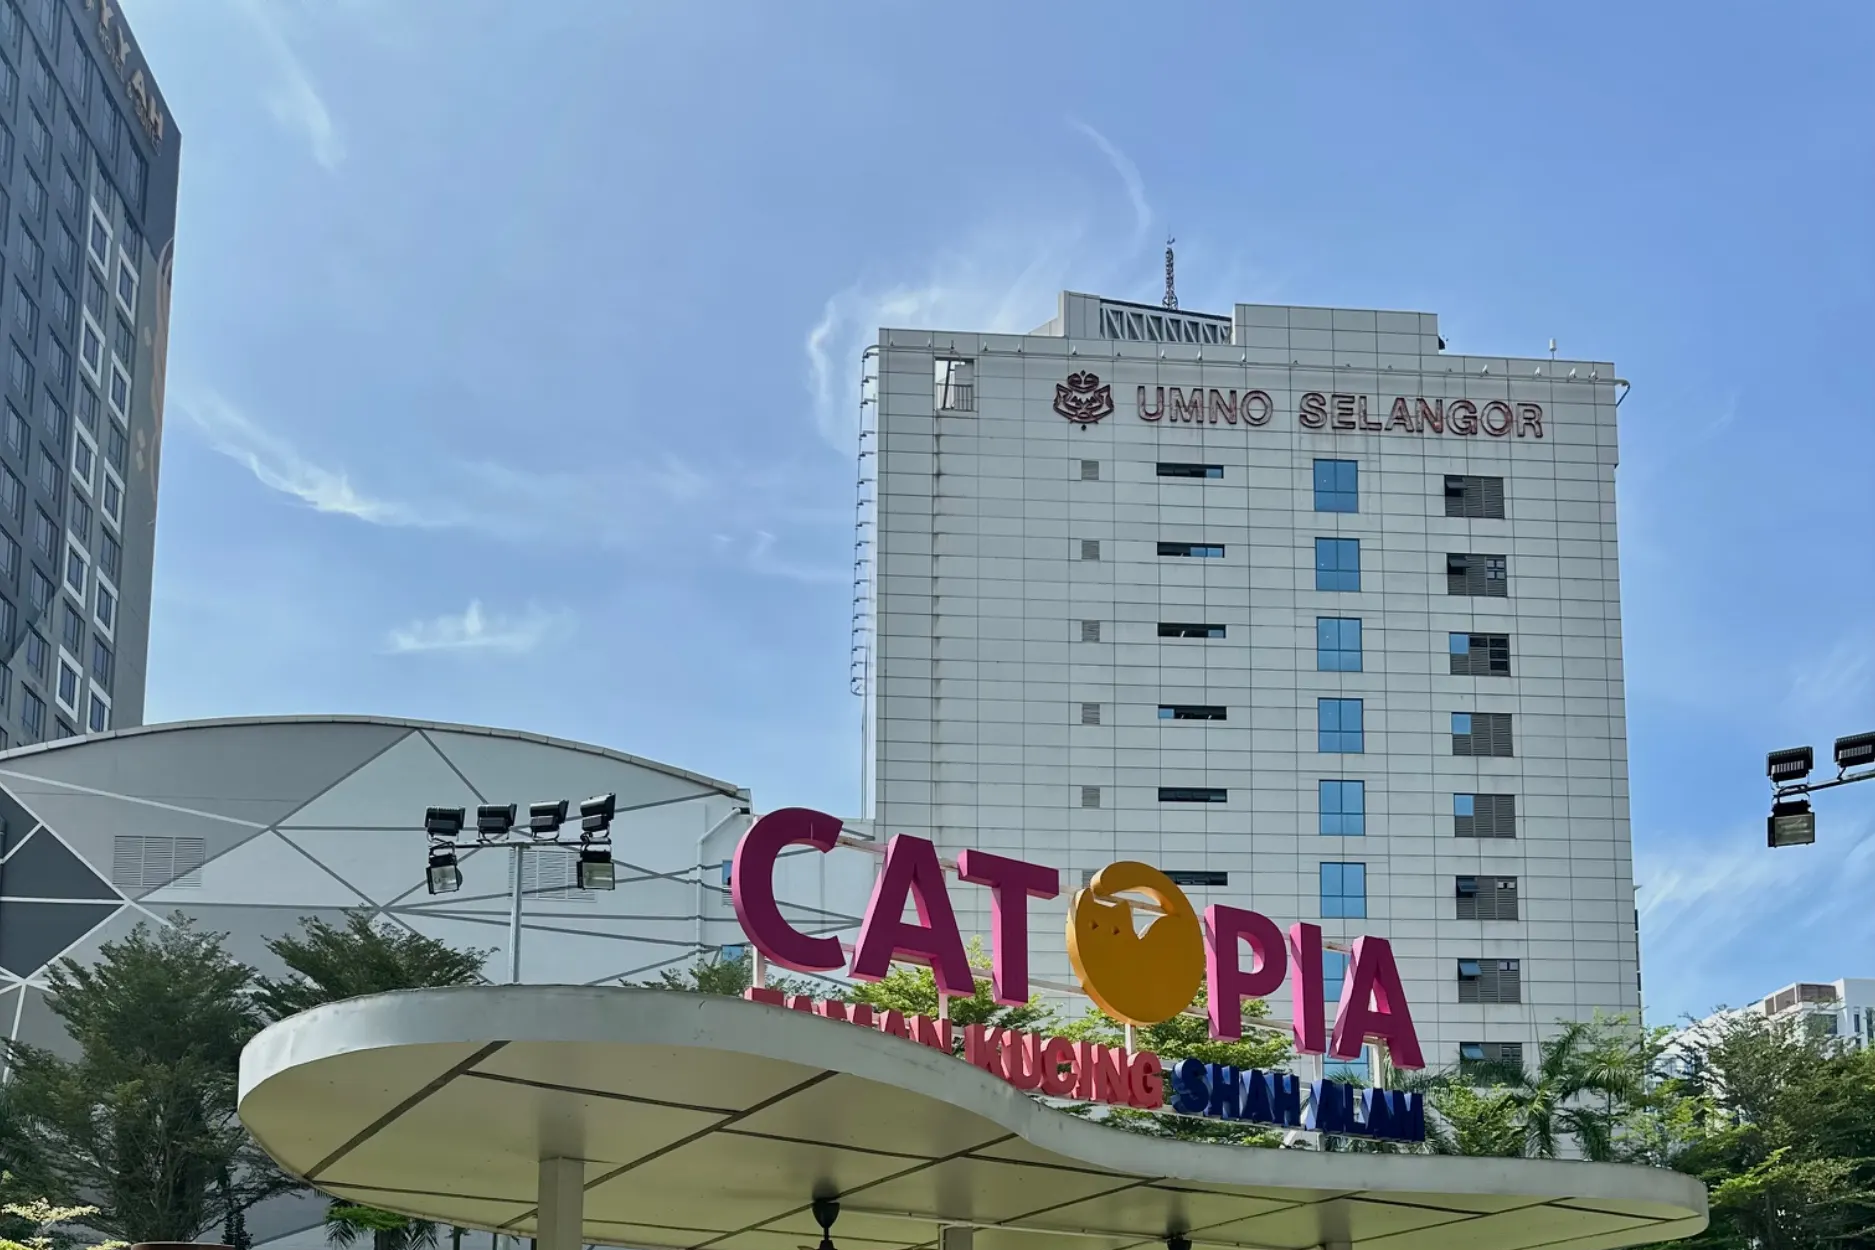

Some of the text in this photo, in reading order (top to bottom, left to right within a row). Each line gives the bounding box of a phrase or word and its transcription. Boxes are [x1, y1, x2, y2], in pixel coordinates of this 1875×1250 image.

[1137, 385, 1544, 439] UMNO SELANGOR
[964, 1023, 1163, 1109] KUCING
[1171, 1058, 1301, 1128] SHAH
[1304, 1078, 1426, 1142] ALAM
